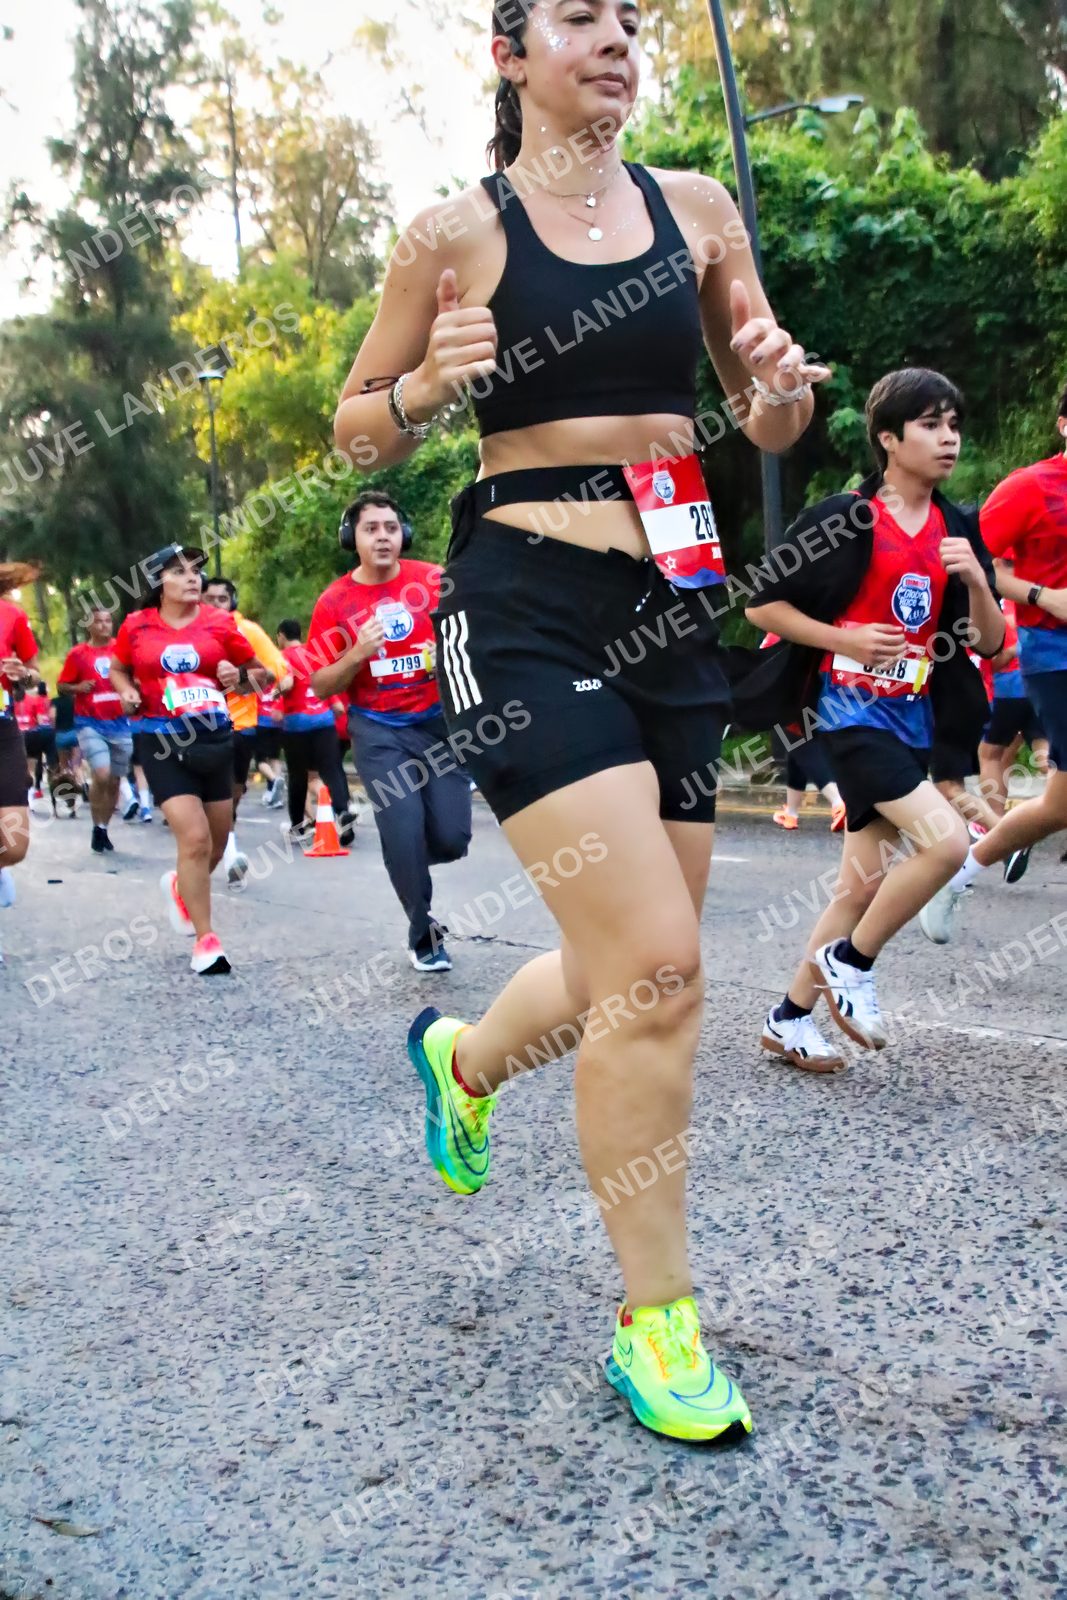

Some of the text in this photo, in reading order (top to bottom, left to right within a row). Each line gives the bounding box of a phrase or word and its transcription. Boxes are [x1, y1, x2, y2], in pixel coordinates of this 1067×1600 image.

[689, 504, 713, 541] 28
[391, 655, 421, 672] 2799
[181, 688, 209, 702] 3579
